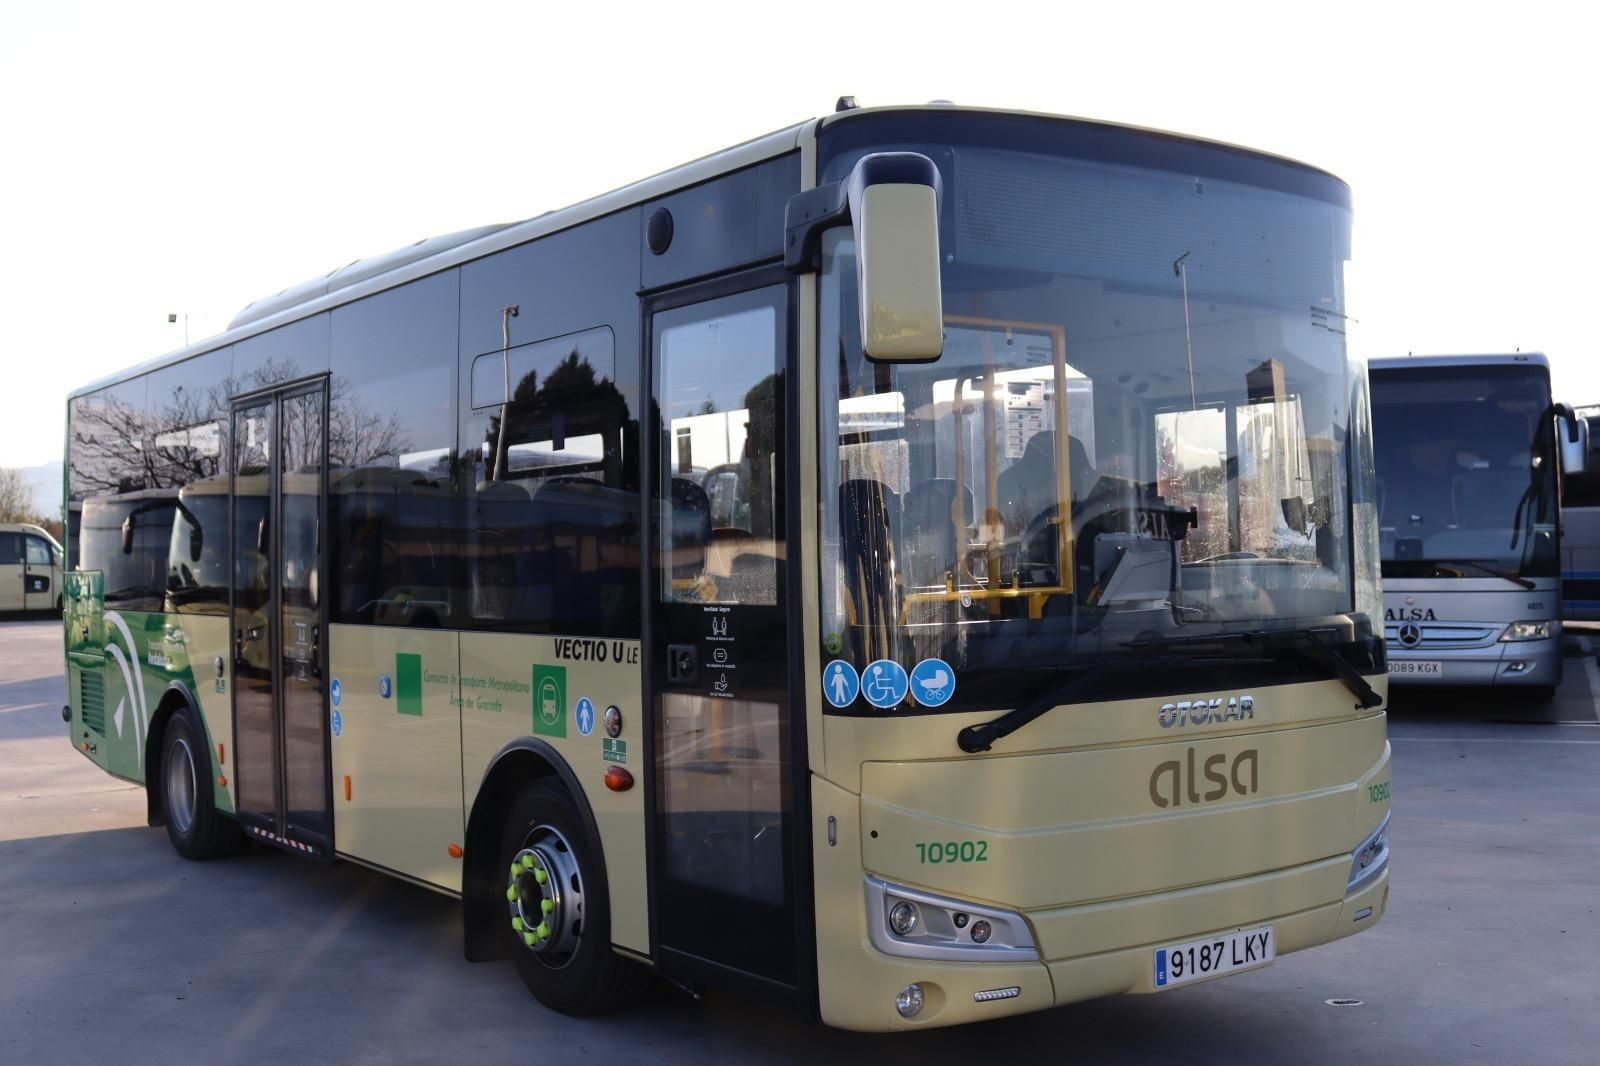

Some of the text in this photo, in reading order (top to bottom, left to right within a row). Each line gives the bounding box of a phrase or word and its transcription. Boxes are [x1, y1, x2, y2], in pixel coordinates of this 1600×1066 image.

[1384, 608, 1438, 621] ALSA
[554, 638, 638, 664] VECTIO U LE
[1417, 663, 1438, 673] KGX
[488, 676, 530, 694] Metropolitano
[476, 696, 502, 712] Granada
[1158, 695, 1255, 728] OTOKAR
[1149, 747, 1258, 808] alsa
[915, 840, 988, 864] 10902
[1171, 941, 1225, 978] 9187
[1232, 931, 1270, 966] LKY
